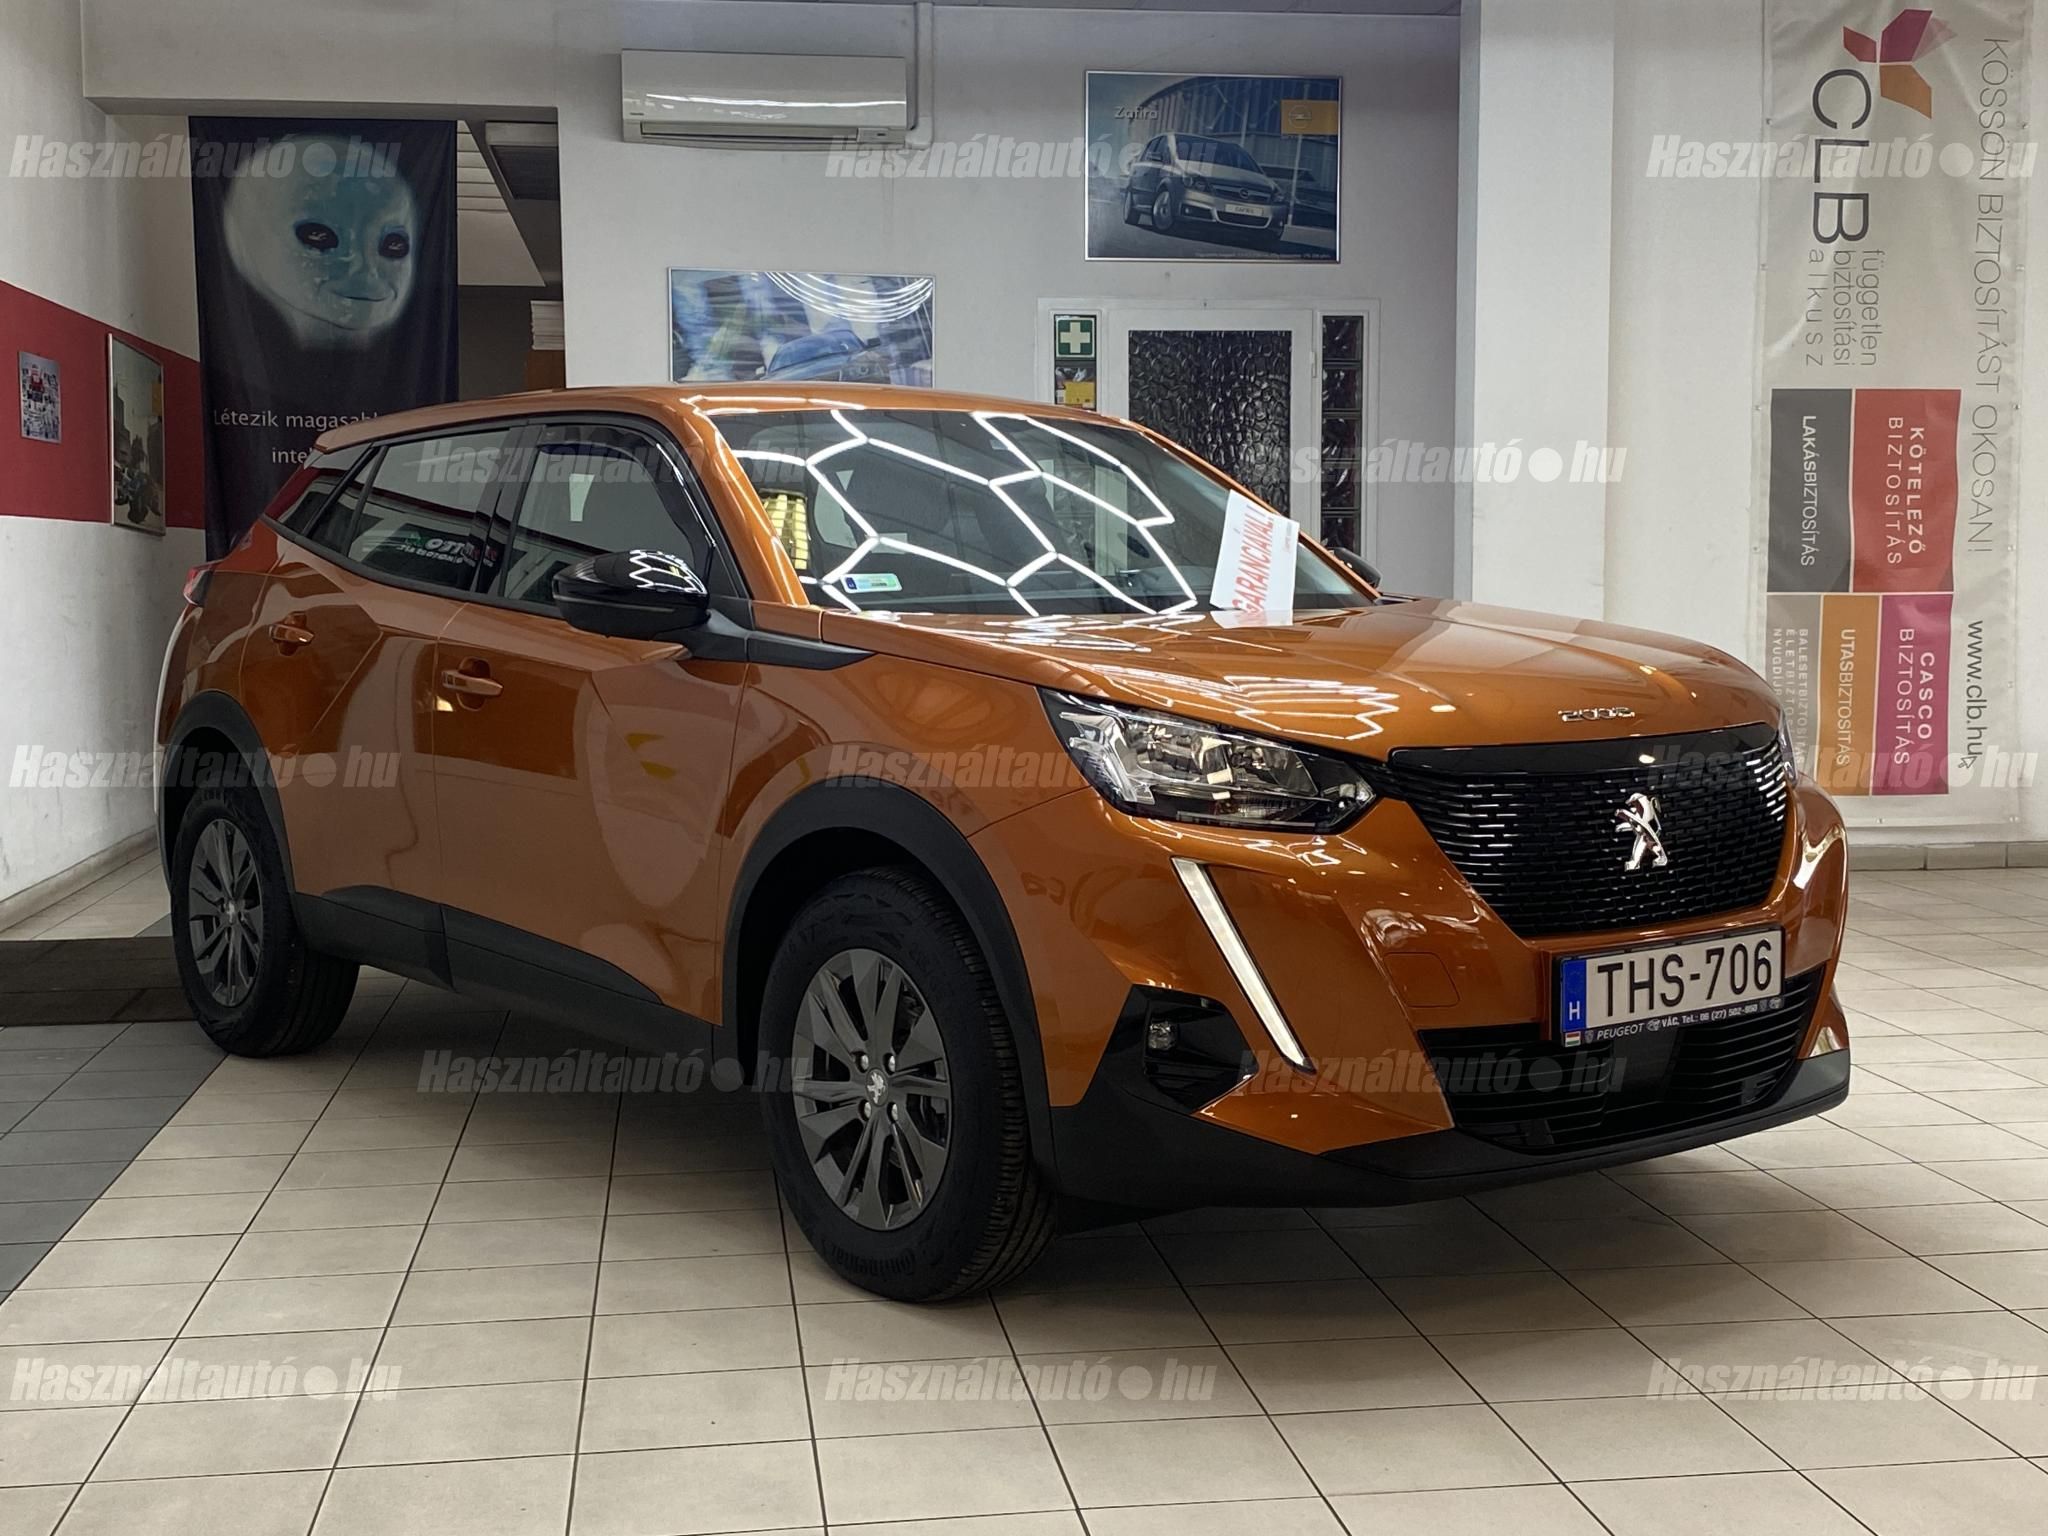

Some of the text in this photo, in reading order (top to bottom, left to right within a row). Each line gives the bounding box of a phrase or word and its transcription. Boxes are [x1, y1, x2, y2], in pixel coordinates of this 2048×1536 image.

[1114, 105, 1160, 122] Zafira
[1812, 68, 1873, 246] CLB
[1833, 250, 1857, 367] biztosítási
[1856, 249, 1885, 367] független
[1968, 38, 2013, 553] KÖSSÖN BIZTOSÍTÁST OKOSAN!
[213, 408, 279, 427] Létezik
[1800, 415, 1822, 567] LAKÁSBIZTOSÍTÁS
[1885, 417, 1903, 565] BIZTOSÍTÁS
[1906, 427, 1928, 555] KÖTELEZŐ
[1835, 629, 1857, 767] UTASBIZTOSÍTÁS
[1894, 628, 1913, 765] BIZTOSÍTÁS
[1919, 652, 1935, 741] CASCO
[1966, 620, 1988, 757] www.clb.hu
[1568, 1000, 1581, 1021] H
[1596, 1022, 1645, 1041] PEUGEOT
[1597, 937, 1773, 1018] THS-706
